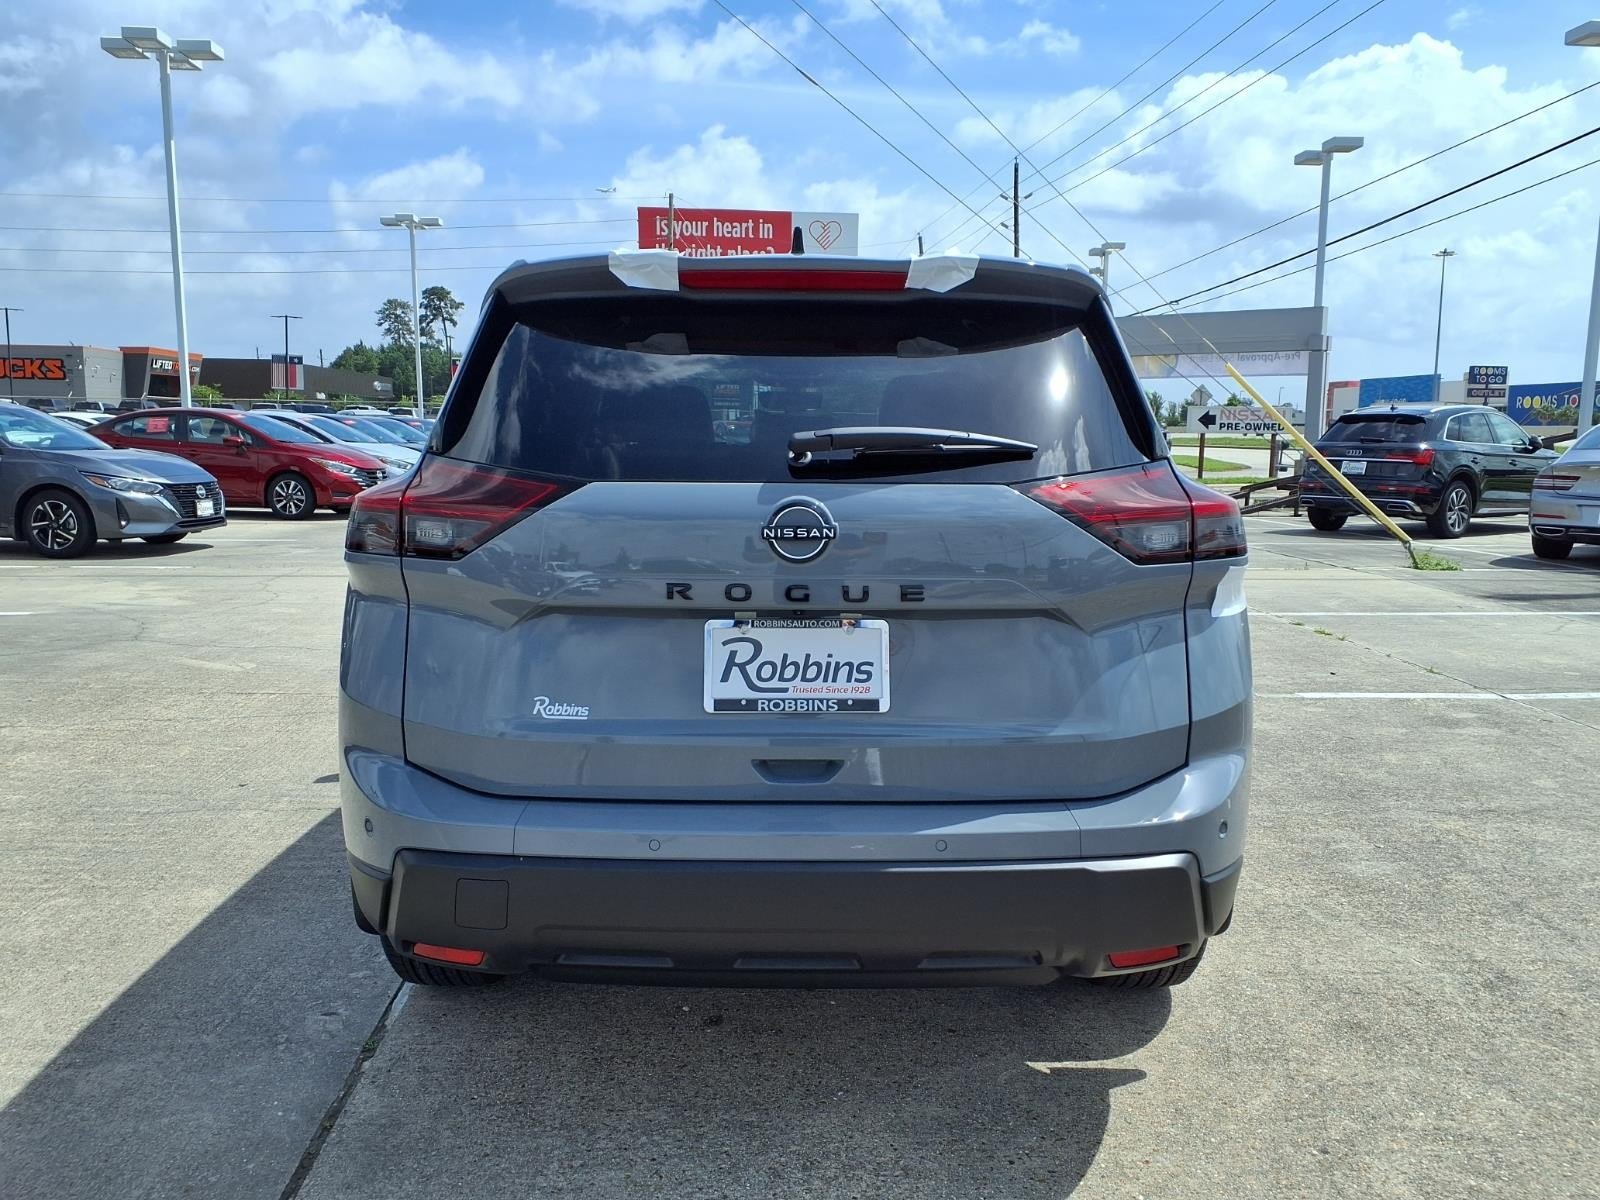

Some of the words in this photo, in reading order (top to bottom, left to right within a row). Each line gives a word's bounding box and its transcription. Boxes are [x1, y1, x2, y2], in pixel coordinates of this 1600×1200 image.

[673, 220, 708, 239] your
[713, 217, 754, 238] heart
[760, 219, 773, 239] in
[0, 358, 65, 380] CKS
[1474, 367, 1506, 375] ROOMS
[1476, 375, 1487, 383] TO
[1488, 375, 1503, 383] GO
[1471, 389, 1505, 397] OUTLET
[1516, 395, 1558, 409] ROOMS
[1564, 394, 1579, 408] TO
[1220, 408, 1287, 421] NISSA
[1219, 422, 1285, 431] PRE-OWNED
[763, 528, 835, 538] NISSAN
[666, 582, 926, 603] ROGUE
[753, 619, 840, 628] ROBBINSAUTO.COM
[720, 636, 875, 694] Robbins
[791, 686, 823, 694] Trusted
[826, 686, 848, 694] Since
[850, 686, 871, 694] 1928
[533, 696, 589, 720] Robbins
[757, 699, 839, 712] ROBBINS
